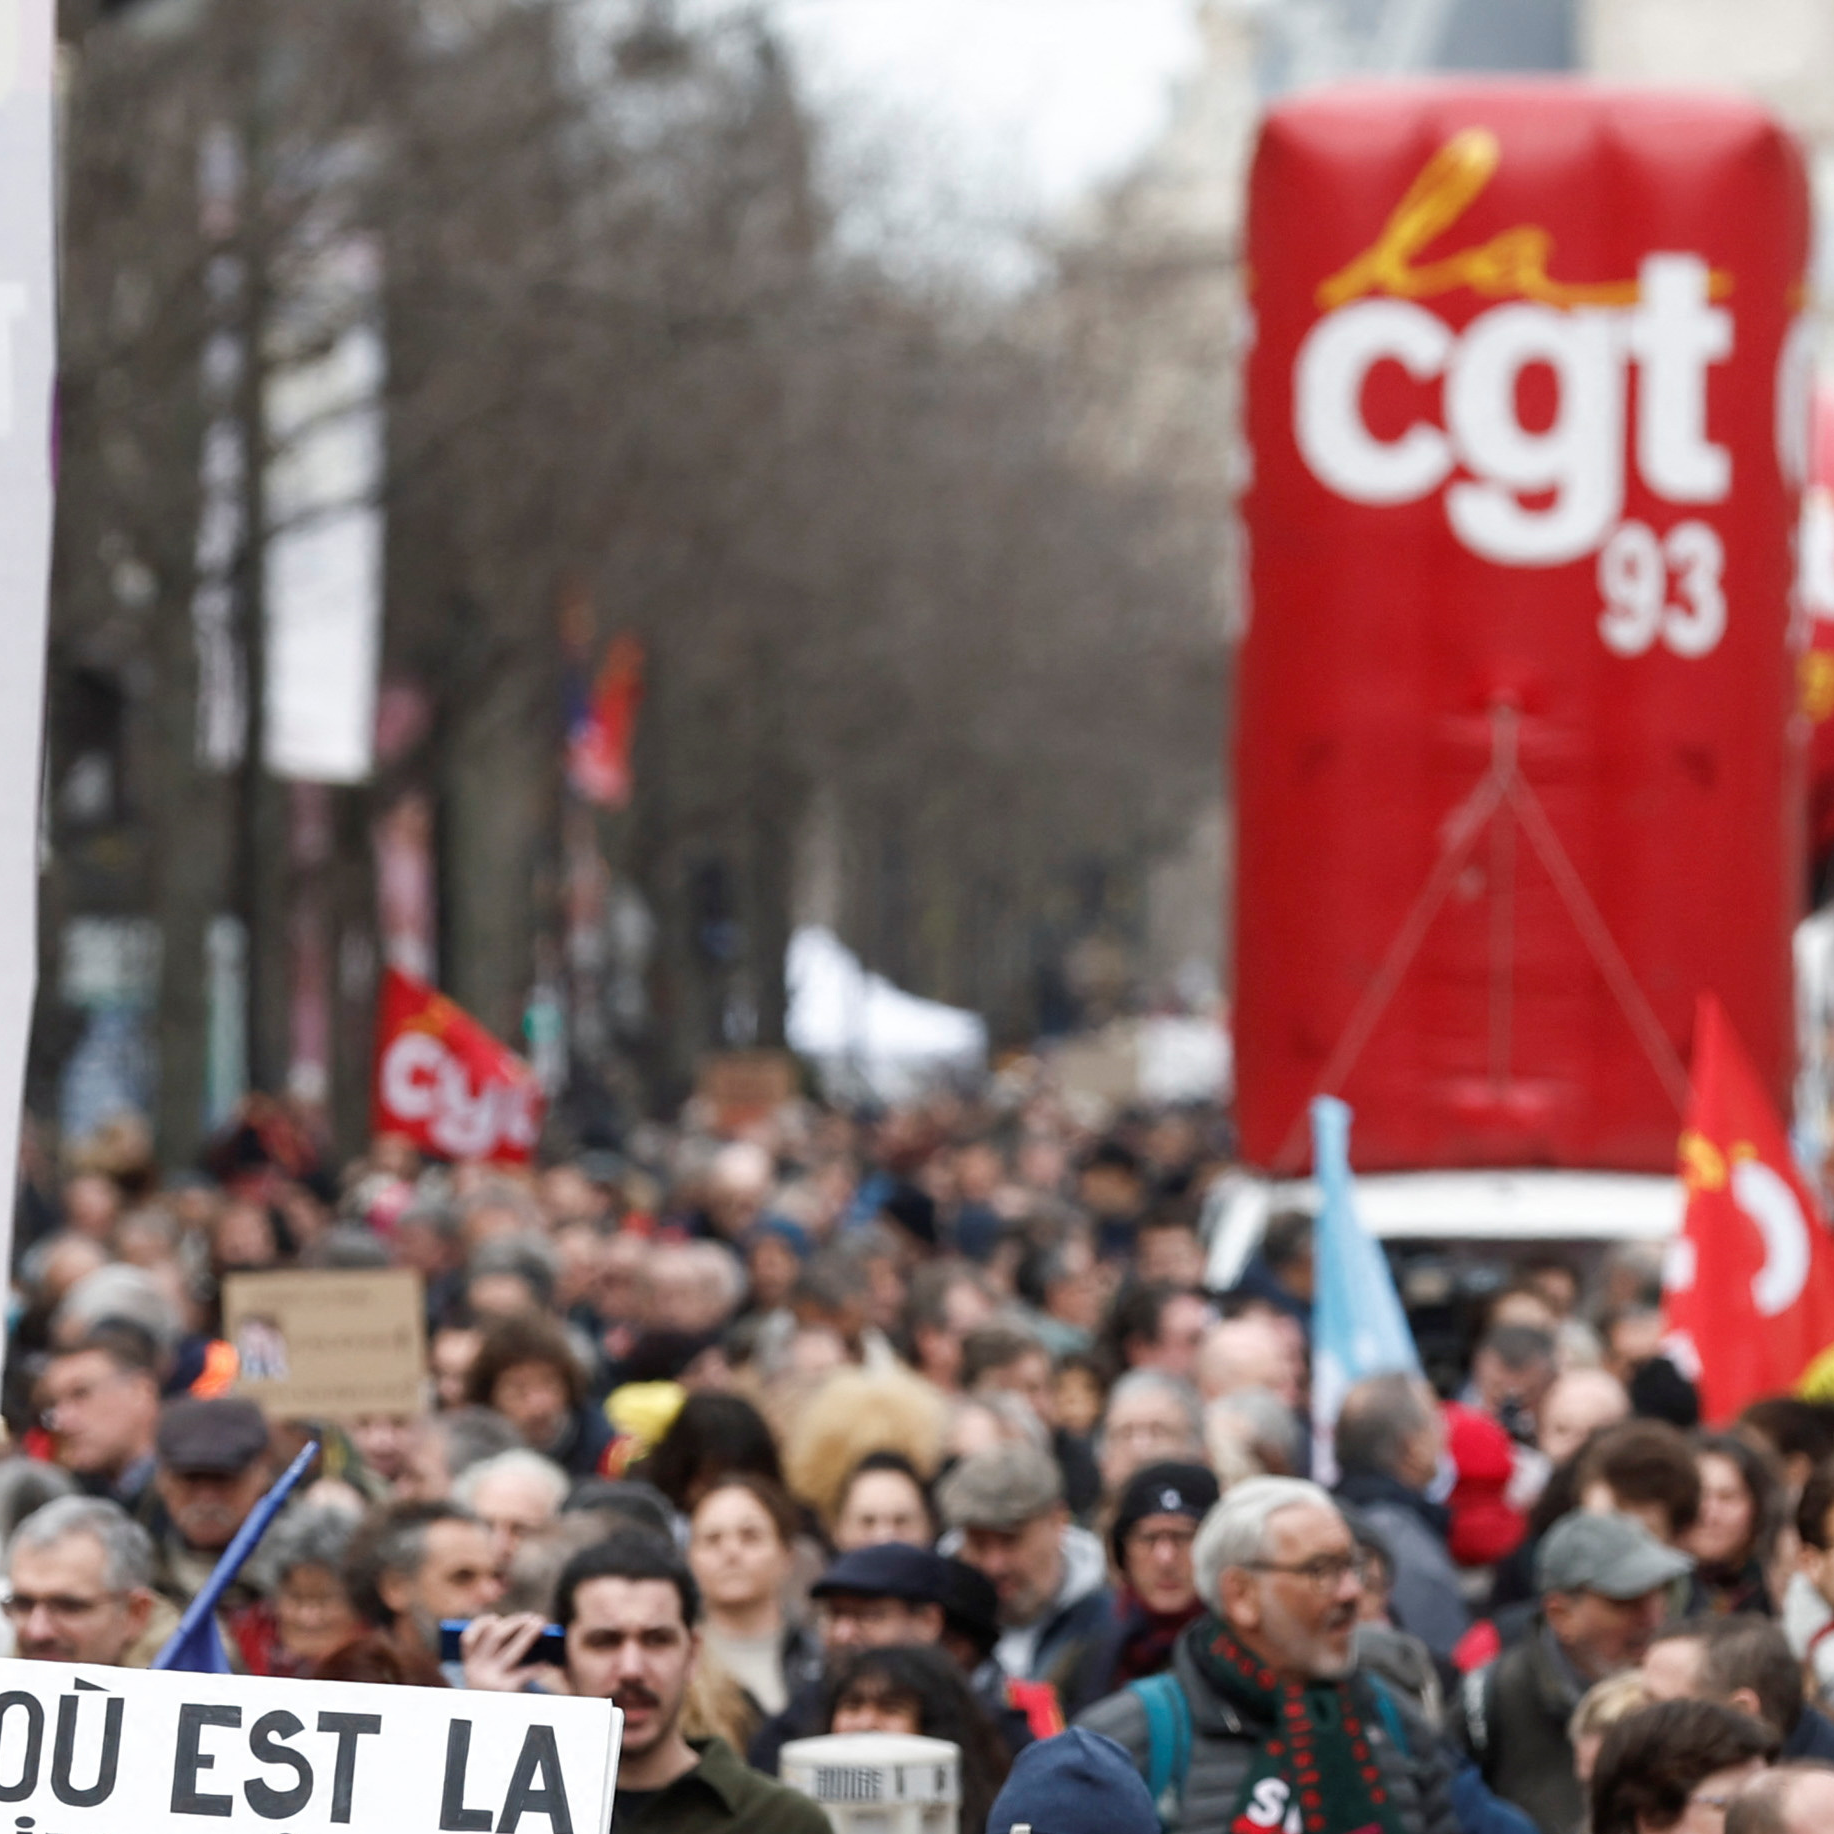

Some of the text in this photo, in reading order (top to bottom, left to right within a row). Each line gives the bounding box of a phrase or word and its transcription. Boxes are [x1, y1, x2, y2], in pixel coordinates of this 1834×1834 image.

[1315, 125, 1667, 310] la
[1292, 251, 1733, 566] cgt
[1598, 520, 1725, 658] 93
[170, 1703, 382, 1824] EST
